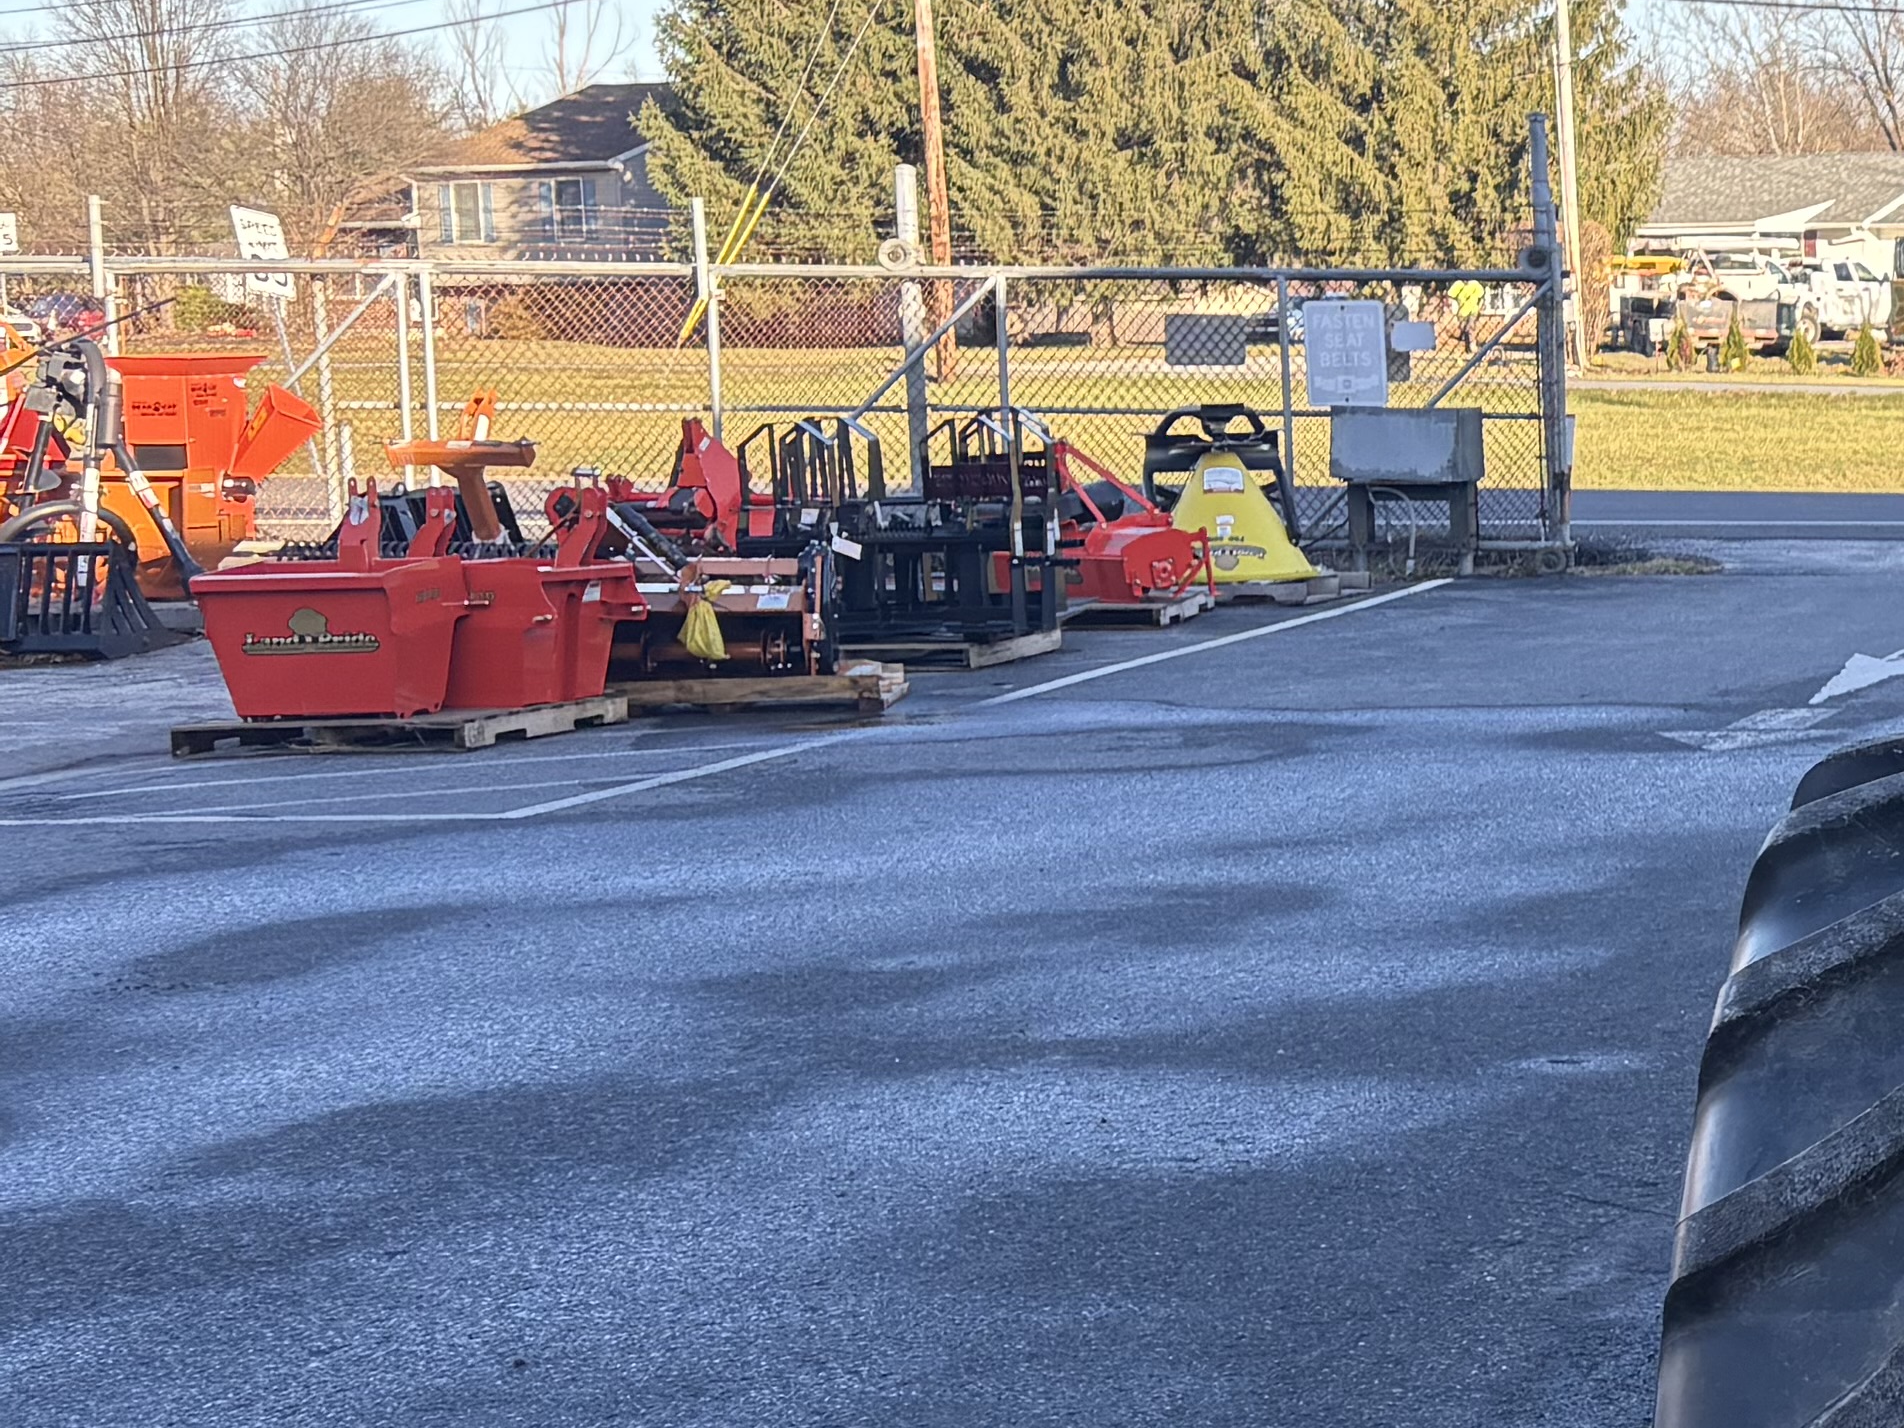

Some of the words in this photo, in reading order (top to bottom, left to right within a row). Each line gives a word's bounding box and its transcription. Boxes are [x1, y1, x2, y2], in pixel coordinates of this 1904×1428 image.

[1311, 312, 1375, 329] FASTEN
[1324, 332, 1364, 348] SEAT
[1320, 350, 1372, 368] BELTS
